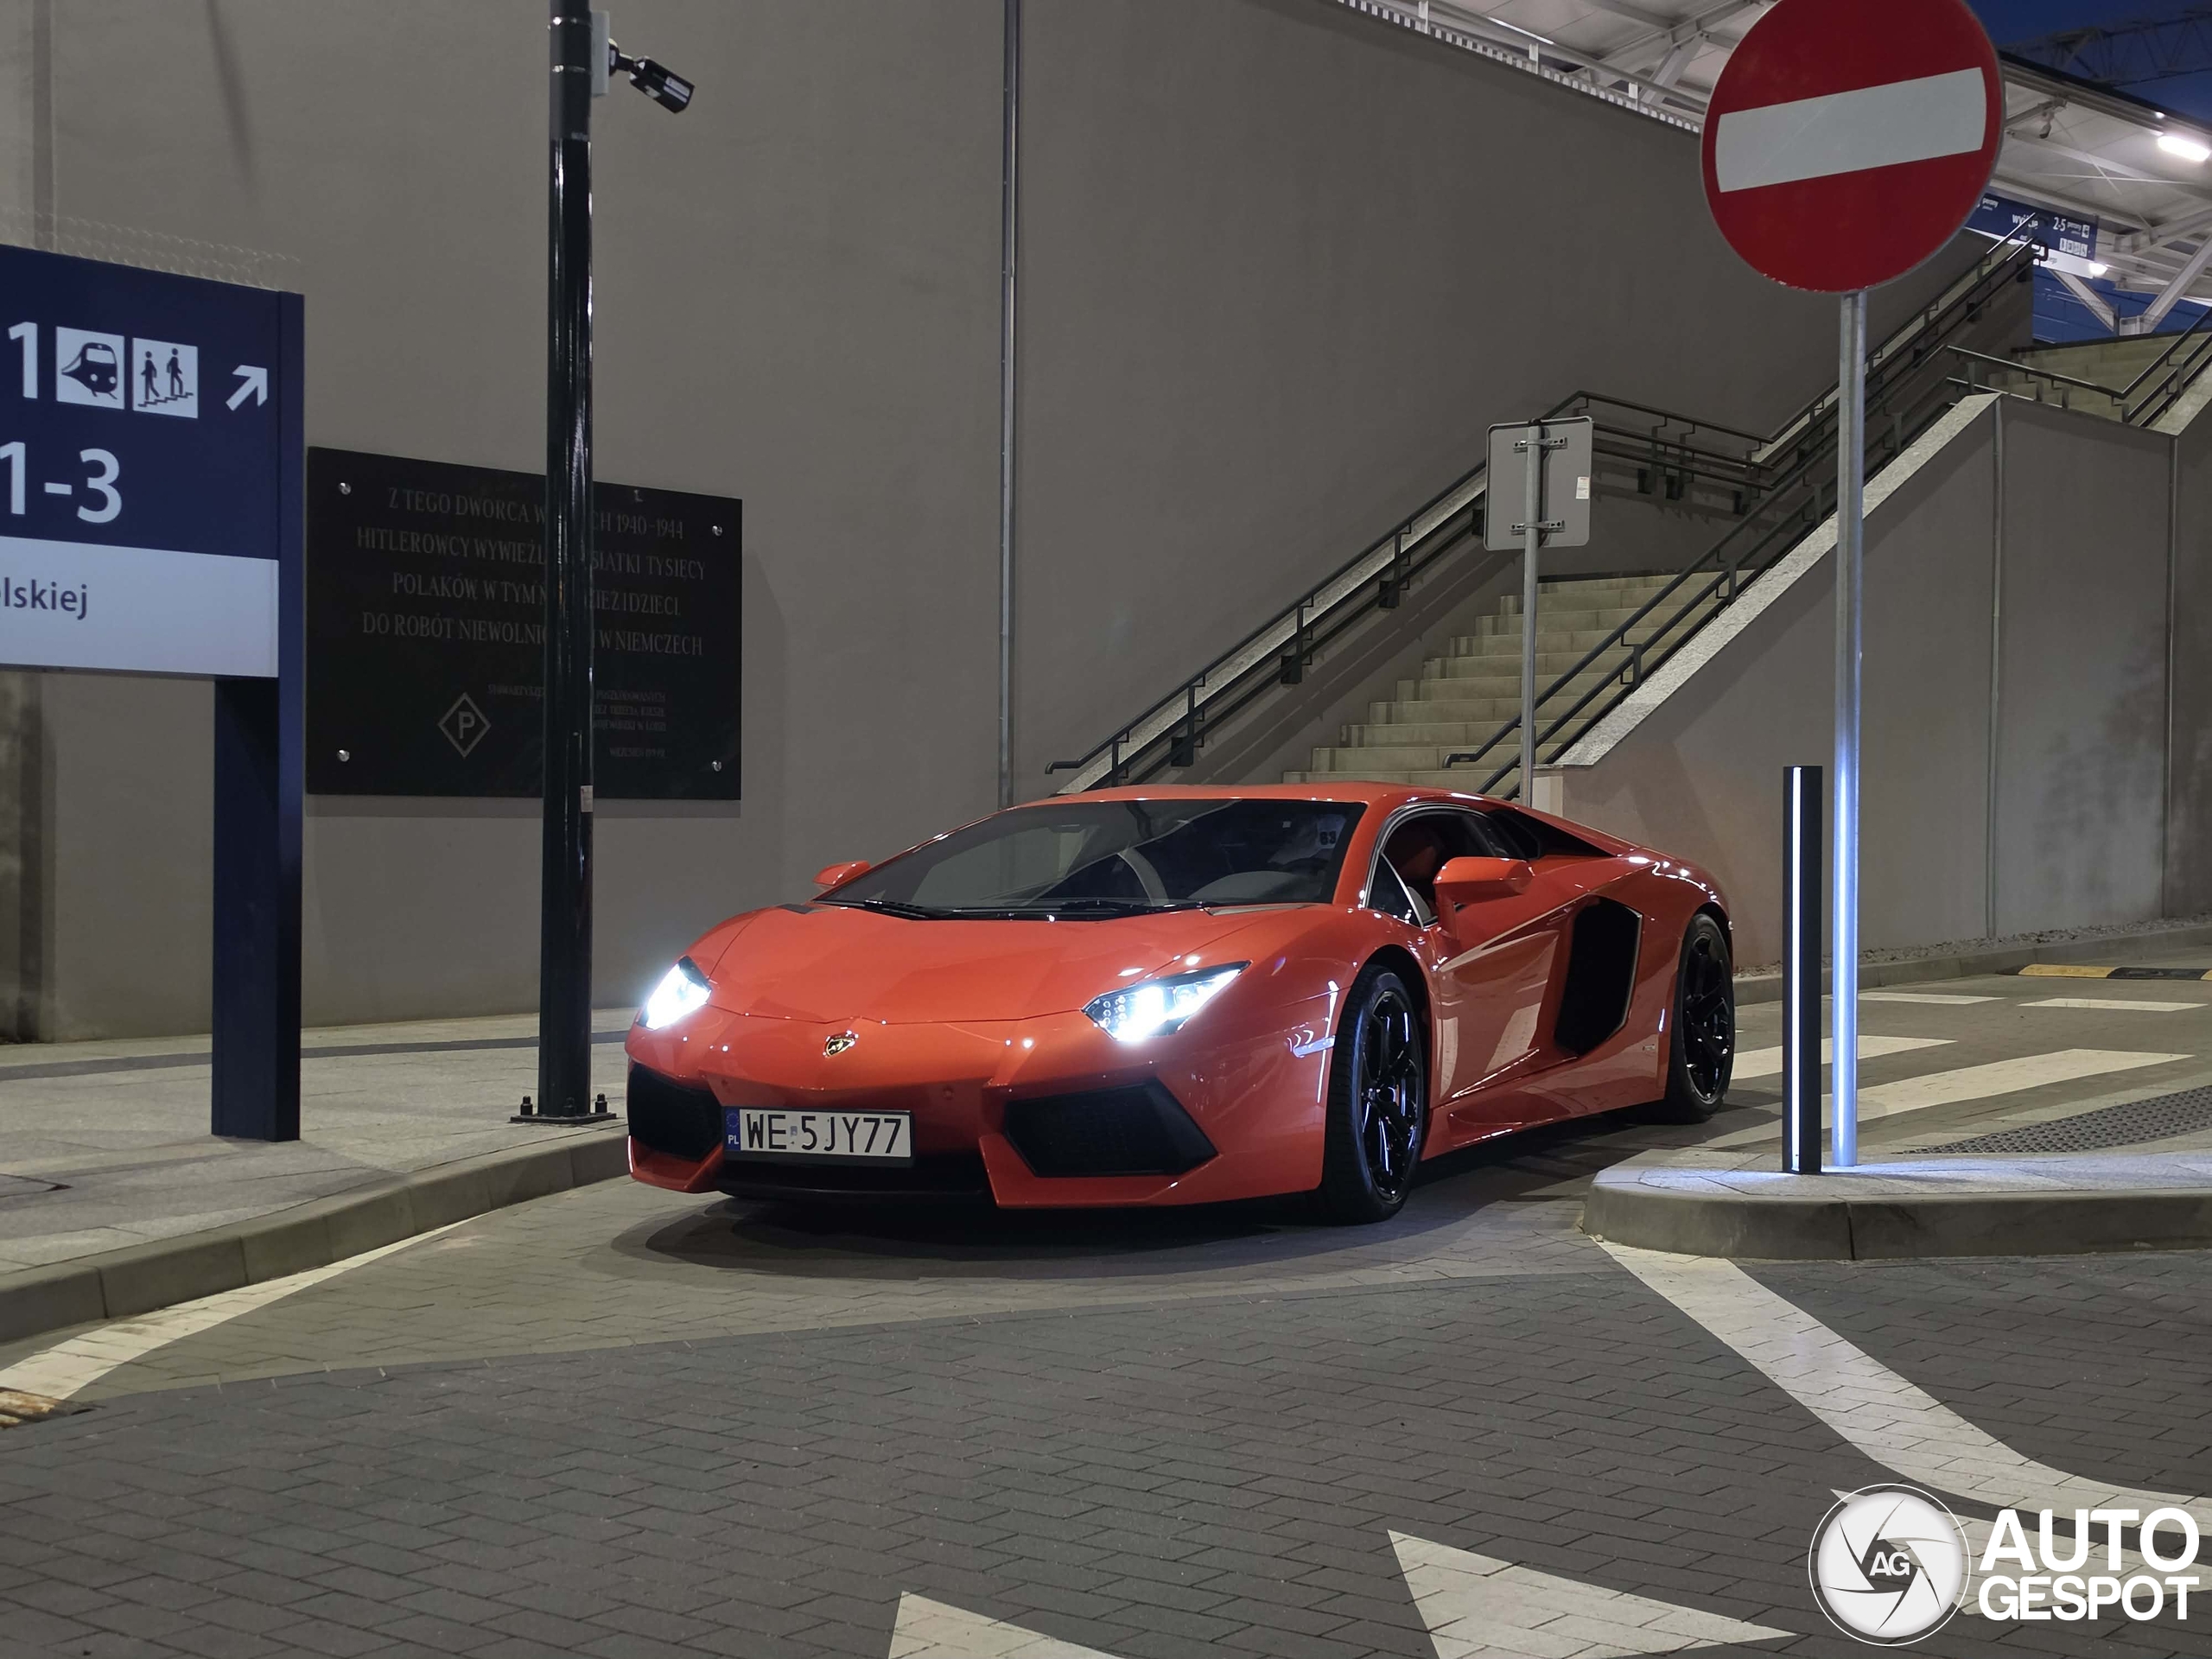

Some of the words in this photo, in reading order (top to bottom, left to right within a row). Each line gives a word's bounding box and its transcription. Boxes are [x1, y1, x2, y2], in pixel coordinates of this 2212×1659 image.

[8, 321, 38, 399] 1
[0, 442, 123, 524] 1-3
[388, 487, 398, 509] Z
[401, 489, 451, 513] TEGO
[454, 494, 531, 524] DWORCA
[616, 513, 683, 541] 1940-1944
[356, 526, 471, 558] HITLEROWCY
[473, 537, 547, 565] WYWIEŹL
[646, 555, 706, 582] TYSIĘCY
[0, 577, 87, 620] lskiej
[482, 580, 498, 601] W
[499, 581, 536, 605] TYM
[362, 611, 390, 634] DO
[394, 613, 454, 639] ROBÓT
[599, 629, 613, 650] W
[615, 631, 703, 657] NIEMCZECH
[458, 711, 475, 739] P
[728, 1135, 739, 1145] PL
